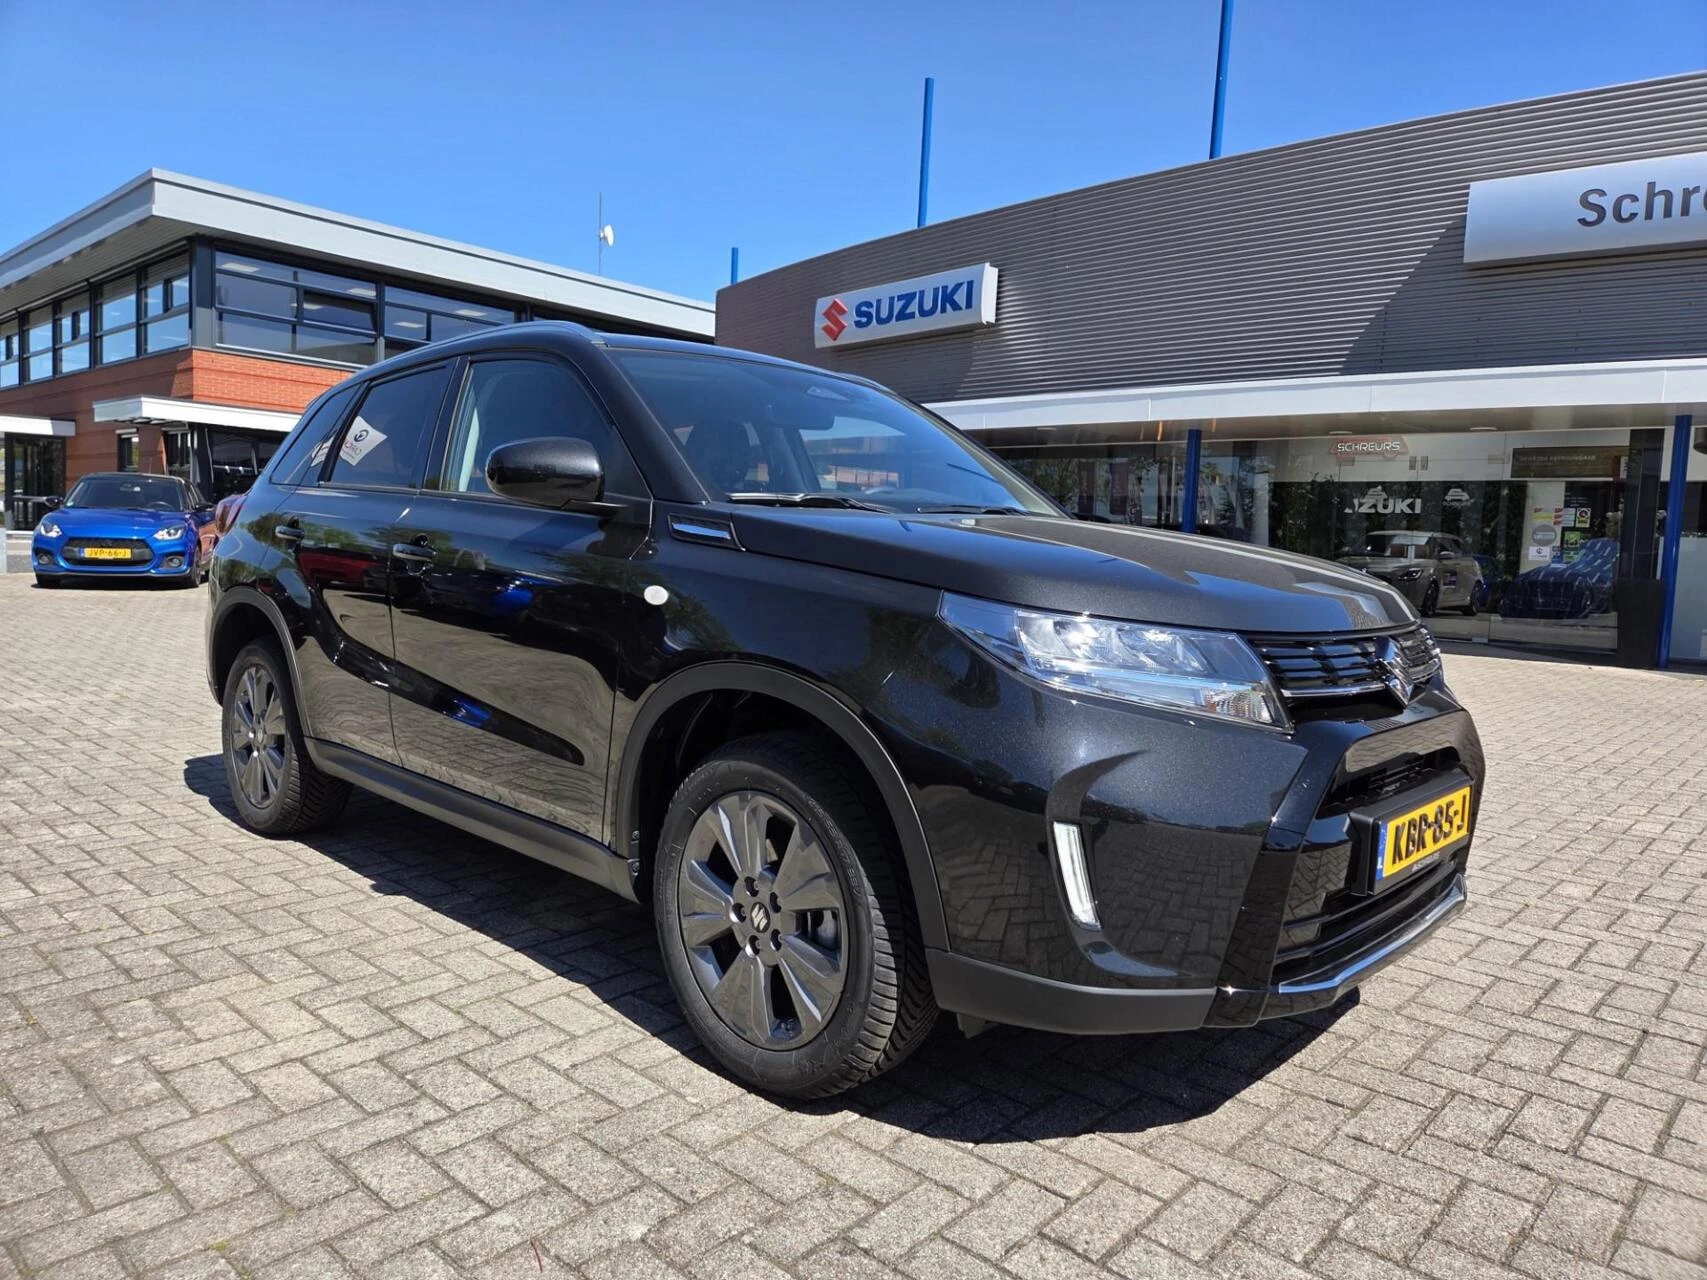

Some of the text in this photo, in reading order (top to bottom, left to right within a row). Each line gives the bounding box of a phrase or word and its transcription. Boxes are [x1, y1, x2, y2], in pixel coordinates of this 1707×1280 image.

[1577, 181, 1707, 228] Schr
[853, 279, 975, 329] SUZUKI
[1337, 441, 1401, 452] SCHREURS
[1391, 794, 1468, 865] KBR-85-J
